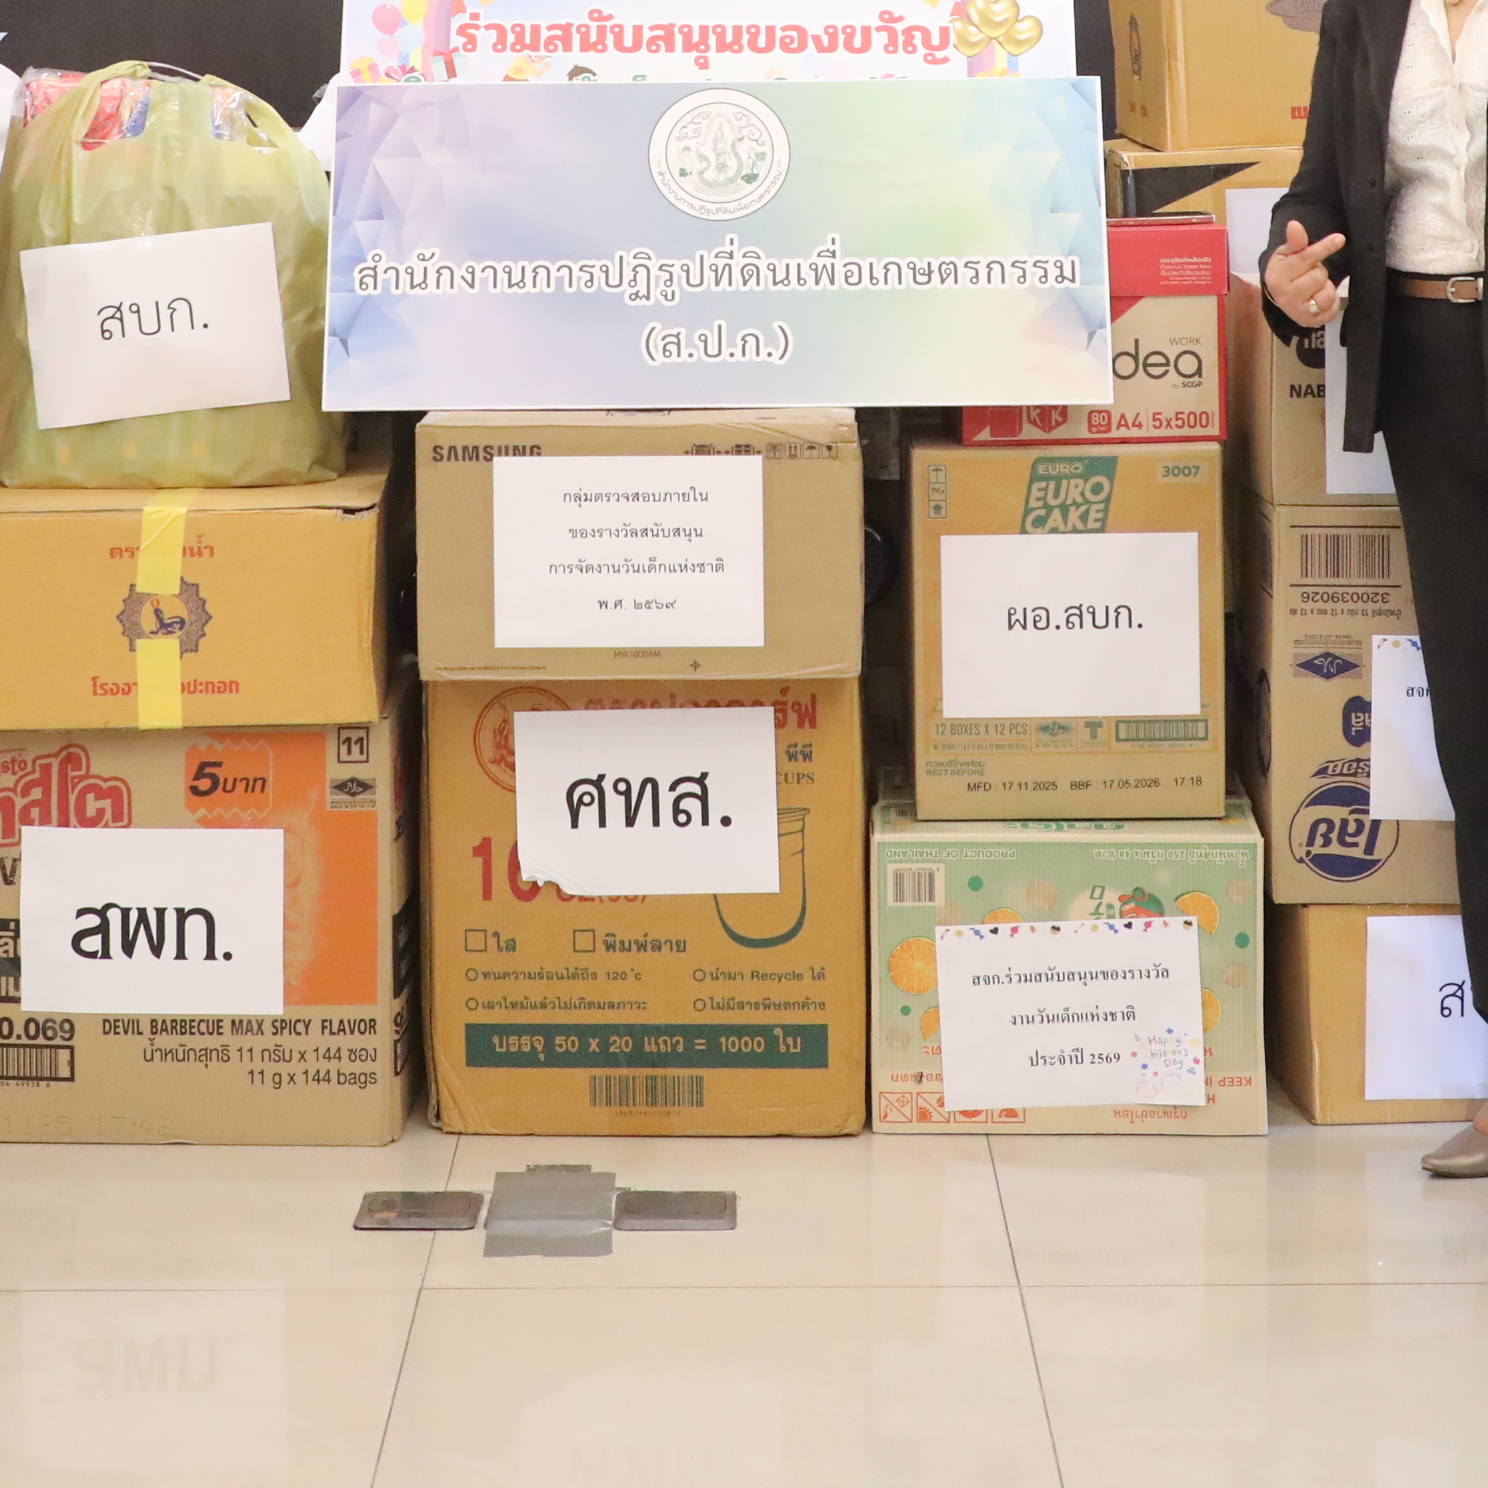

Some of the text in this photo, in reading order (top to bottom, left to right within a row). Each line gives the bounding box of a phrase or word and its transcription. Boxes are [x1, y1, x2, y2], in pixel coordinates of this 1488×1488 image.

[455, 9, 953, 70] ร่วมสนับสนุนของขวัญ
[356, 236, 1079, 302] สำนักงานการปฏิรูปที่ดินเพื่อเกษตรกรรม
[96, 295, 211, 341] สบก.
[644, 322, 792, 364] (ส.ป.ก.)
[1169, 336, 1202, 347] WORK
[1112, 337, 1203, 381] dea
[1181, 380, 1203, 389] SCGP
[1289, 383, 1326, 399] NAB
[1091, 412, 1108, 425] 80
[1115, 412, 1144, 431] A4
[1151, 410, 1211, 430] 5x500
[1037, 462, 1085, 476] EURO
[1161, 465, 1201, 478] 3007
[562, 485, 710, 509] กลุ่มตรวจสอบภายใน
[1027, 475, 1112, 509] EURO
[1024, 502, 1106, 534] CAKE
[568, 522, 704, 543] ของรางวัลสนับสนุน
[548, 555, 726, 574] การจัดงานวันเด็กแห่งชาติ
[597, 598, 677, 611] พ.ศ. ๒๕๖๙
[1300, 591, 1391, 604] 320039026
[1006, 603, 1144, 632] ผอ.สบก.
[935, 723, 1028, 736] 12 BOXES X 12 PCS
[340, 736, 365, 757] 11
[188, 760, 268, 798] 5 บาท
[966, 781, 992, 792] MFD
[1070, 776, 1203, 791] BBF 17.05.2026 17:18
[564, 771, 734, 829] ศทส.
[885, 848, 1016, 860] PRODUCT OF THAILAND
[70, 901, 234, 962] สพท.
[491, 929, 517, 953] ใส
[602, 932, 687, 954] พิมพ์ลาย
[606, 971, 628, 981] 120
[750, 969, 804, 984] Recycle
[971, 962, 1170, 987] สจก.ร่วมสนับสนุนของรางวัล
[1009, 1004, 1137, 1026] งานวันเด็กแห่งชาติ
[101, 1018, 144, 1036] DEVIL
[149, 1018, 224, 1036] BARBECUE
[230, 1018, 265, 1036] MAX
[271, 1018, 312, 1036] SPICY
[320, 1018, 378, 1036] FLAVOR
[142, 1036, 378, 1069] น้ำหนักสุทธิ 11 กรัม x 144 ซอง
[492, 1035, 545, 1062] บรรจุ
[554, 1035, 580, 1053] 50
[588, 1038, 601, 1053] x
[608, 1035, 633, 1053] 20
[643, 1035, 684, 1053] แถว
[718, 1035, 765, 1053] 1000
[773, 1027, 802, 1053] ใบ
[1028, 1047, 1122, 1067] ประจำปี 2569
[246, 1068, 378, 1090] 11 g x 144 bags
[1218, 1076, 1252, 1087] KEEP
